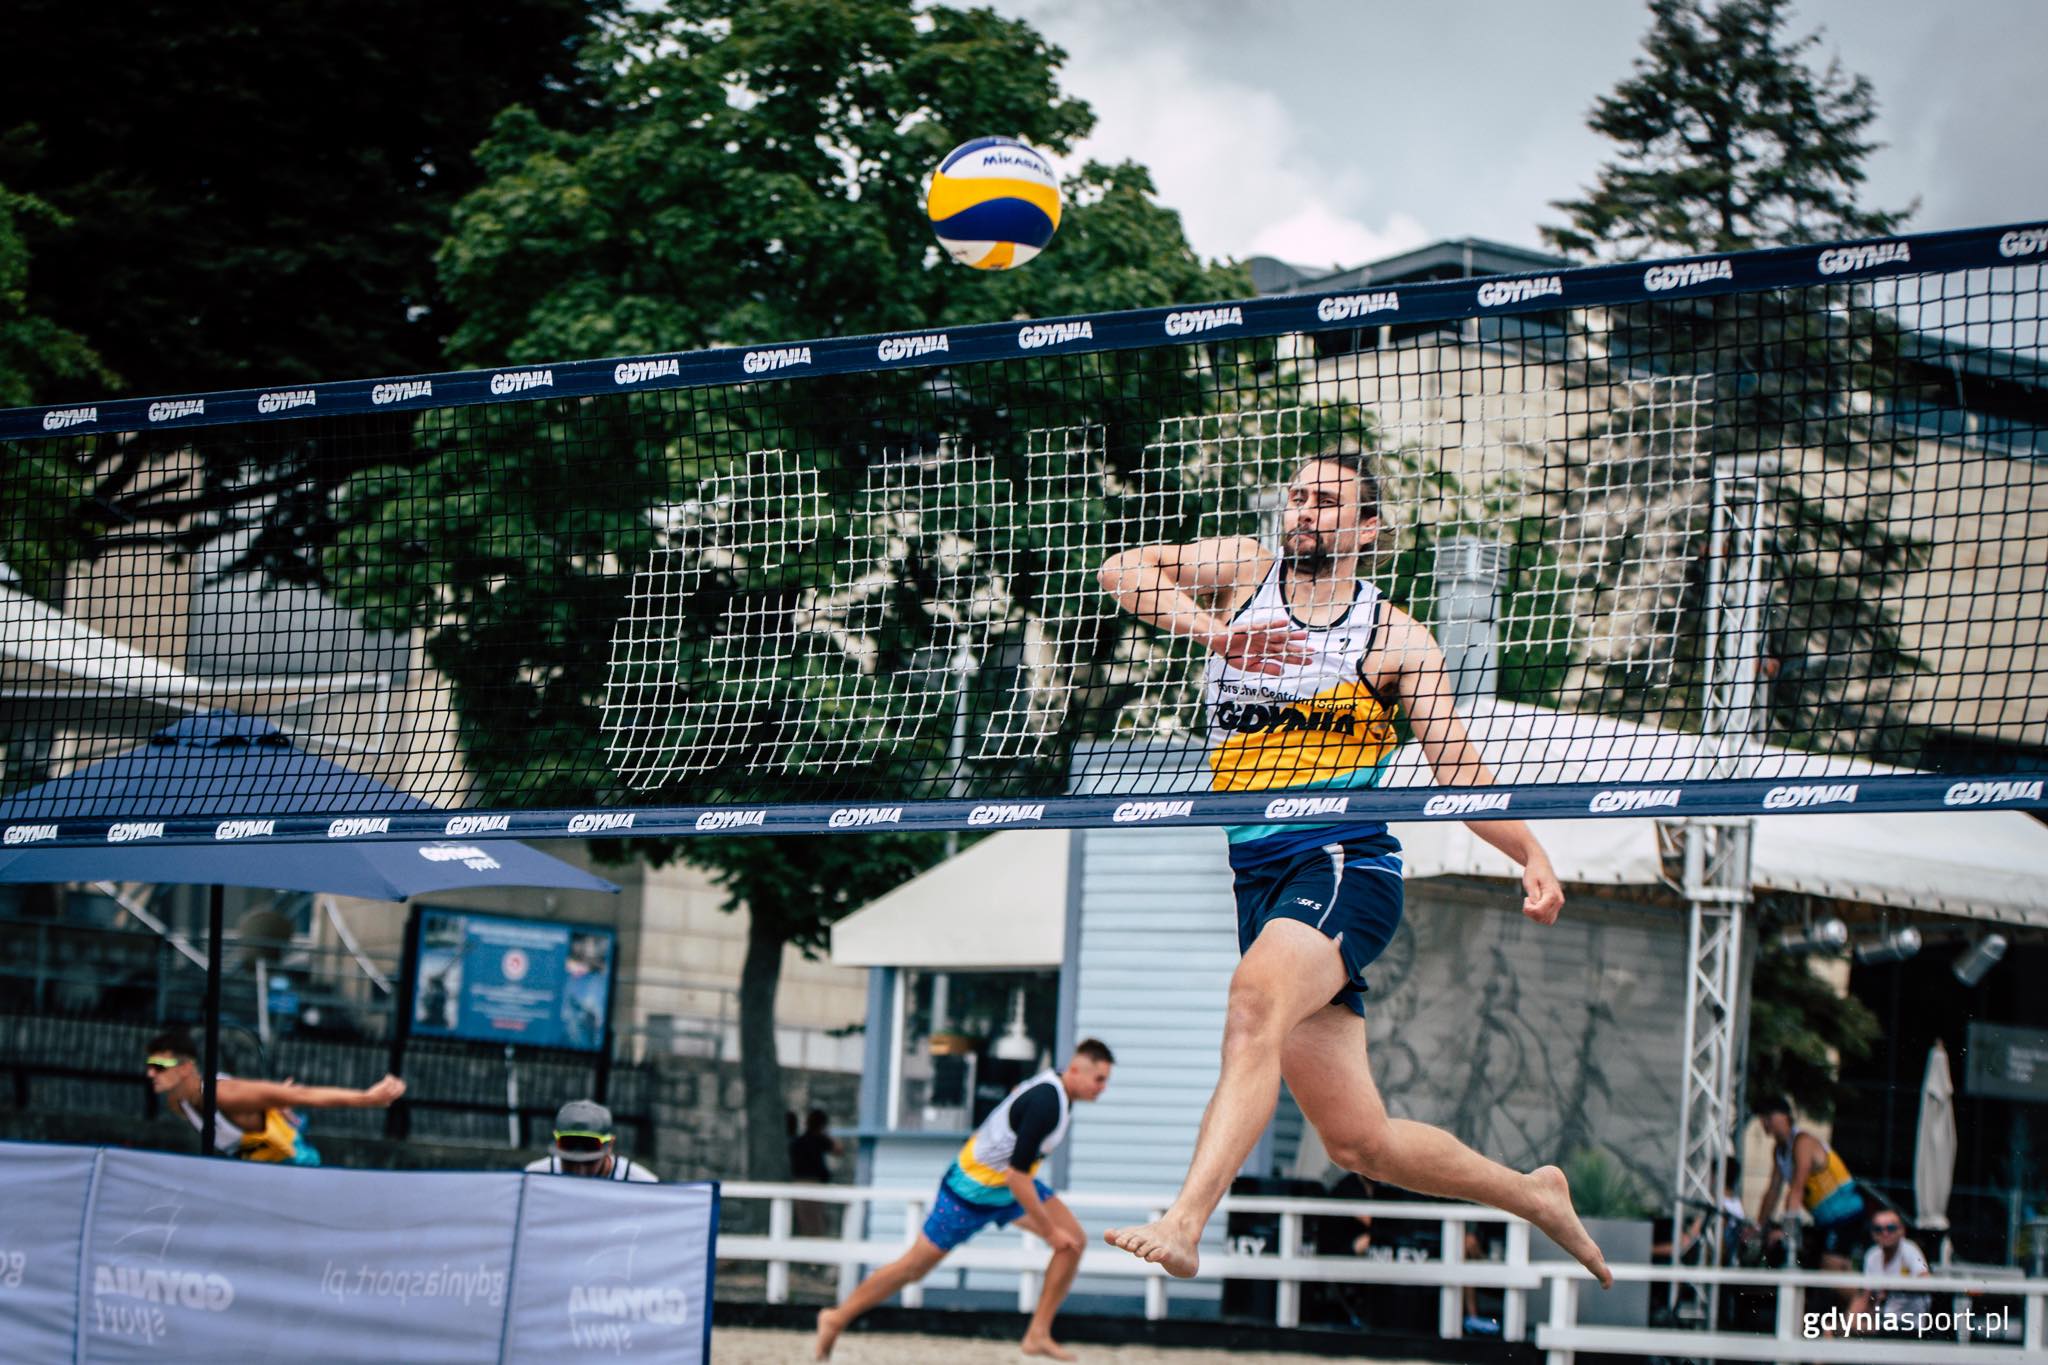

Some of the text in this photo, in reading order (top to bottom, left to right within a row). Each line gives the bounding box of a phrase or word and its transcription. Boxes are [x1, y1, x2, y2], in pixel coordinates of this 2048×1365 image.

[43, 408, 96, 429] GDYNIA
[149, 400, 203, 421] GDYNIA
[258, 391, 315, 413] GDYNIA
[372, 381, 431, 404] GDYNIA
[491, 370, 552, 394] GDYNIA
[615, 360, 679, 384] GDYNIA
[743, 346, 812, 374] GDYNIA
[878, 335, 948, 361] GDYNIA
[1018, 320, 1093, 349] GDYNIA
[1165, 308, 1242, 335] GDYNIA
[1318, 292, 1399, 321] GDYNIA
[1478, 277, 1562, 306] GDYNIA
[1643, 259, 1733, 291] GDYNIA
[1818, 242, 1911, 276] GDYNIA
[1217, 700, 1356, 736] GDYNIA
[4, 781, 2044, 844] GDYNIA GDYNIA GDYNIA GDYNIA GDYNIA GDYNIA GDYNIA GDYNIA GDYNIA GDYNIA GDYNIA GDYNIA GDYNIA GDYNIA GDYNIA
